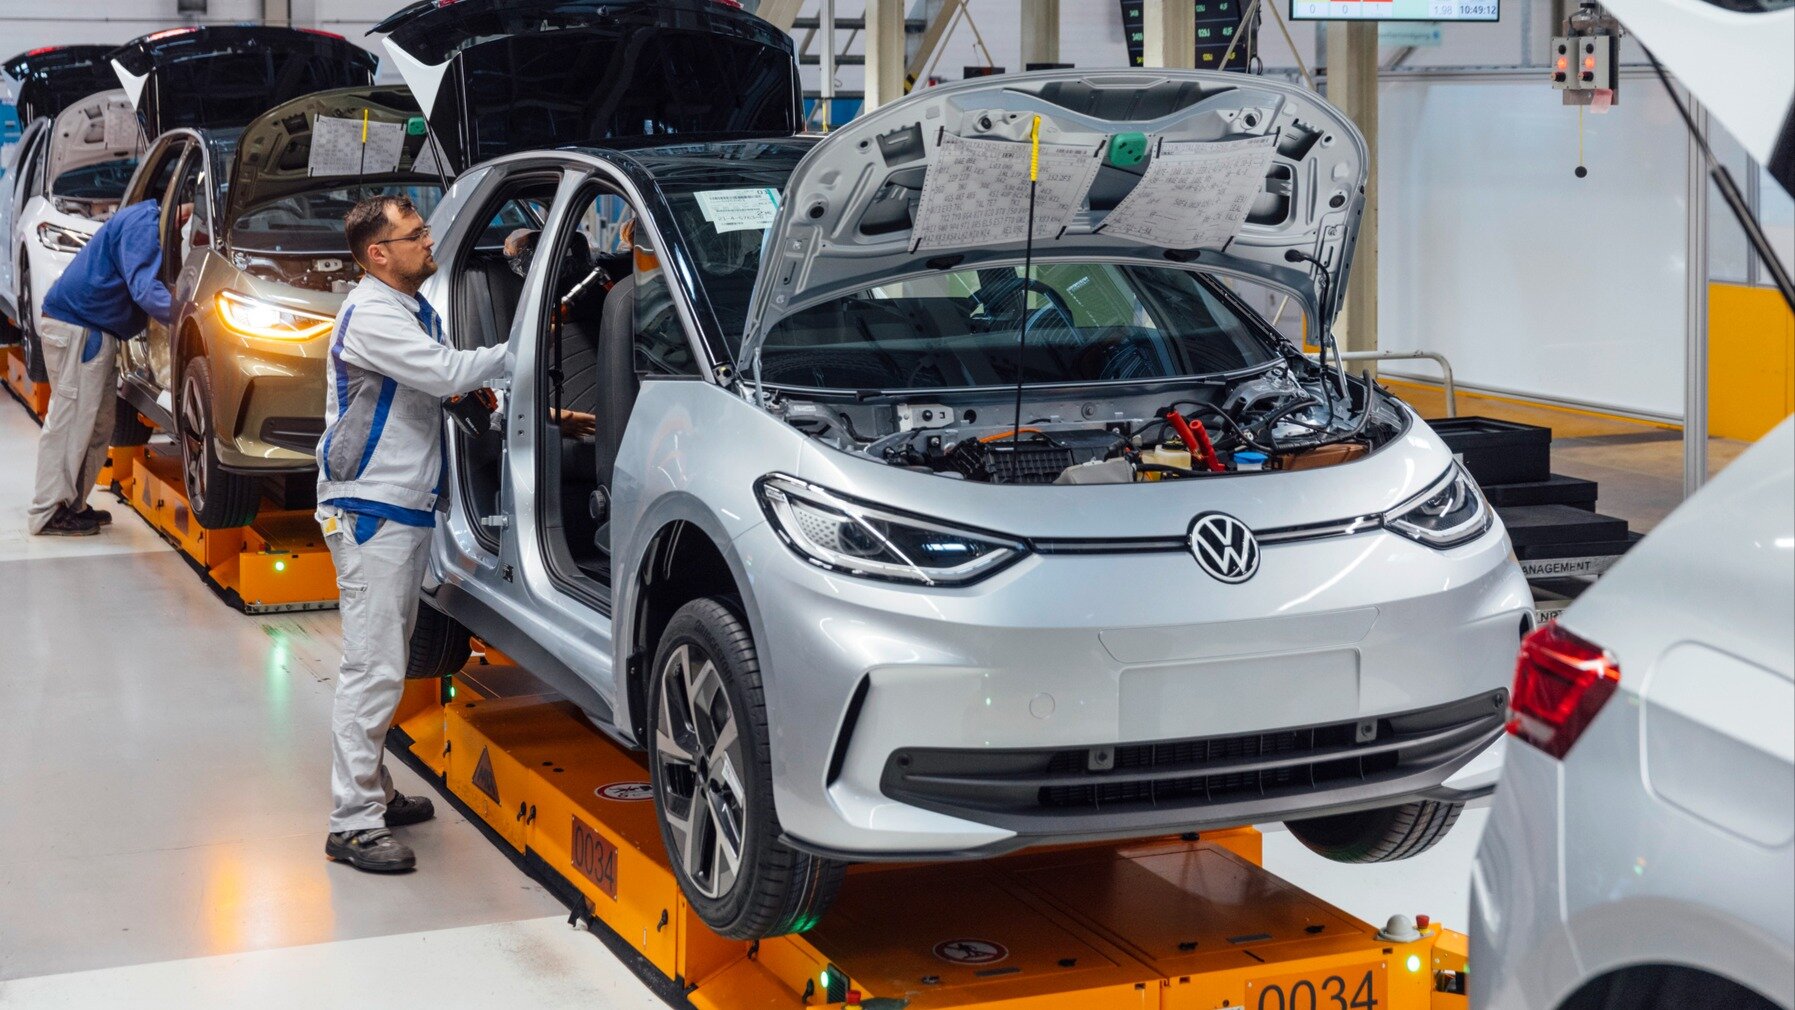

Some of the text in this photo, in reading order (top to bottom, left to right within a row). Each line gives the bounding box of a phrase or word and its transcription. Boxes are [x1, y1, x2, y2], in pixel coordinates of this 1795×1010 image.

[1460, 5, 1496, 14] 10:49:12
[1522, 561, 1591, 575] ANAGEMENT
[575, 825, 615, 893] 0034
[1258, 970, 1378, 1010] 0034
